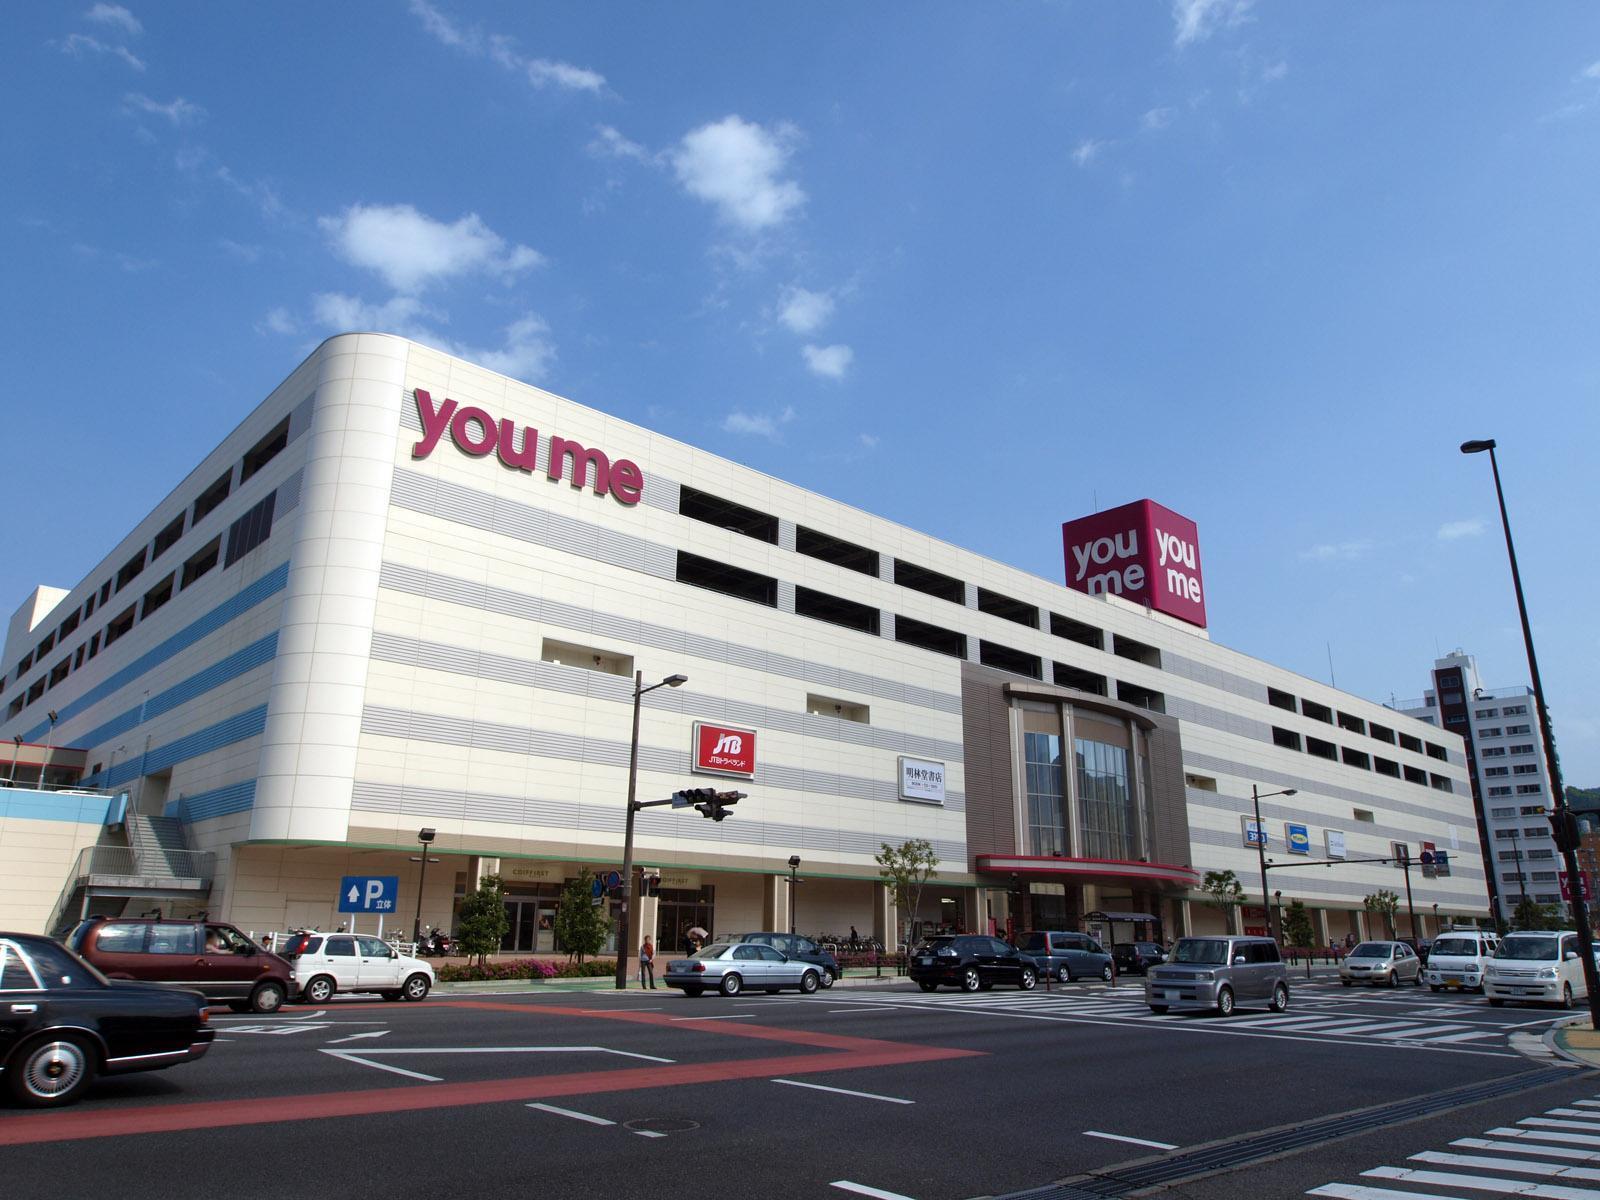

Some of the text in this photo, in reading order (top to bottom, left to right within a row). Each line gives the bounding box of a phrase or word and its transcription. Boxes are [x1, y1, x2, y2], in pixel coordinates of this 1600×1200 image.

[412, 387, 644, 506] you me
[1072, 529, 1138, 581] you
[1155, 528, 1196, 570] you
[1087, 563, 1145, 595] me
[1166, 568, 1201, 603] me
[712, 733, 742, 755] JTB
[708, 756, 746, 767] JTBトラベランド
[906, 767, 942, 783] 明林堂書店
[364, 880, 384, 909] P
[376, 899, 392, 909] 立体
